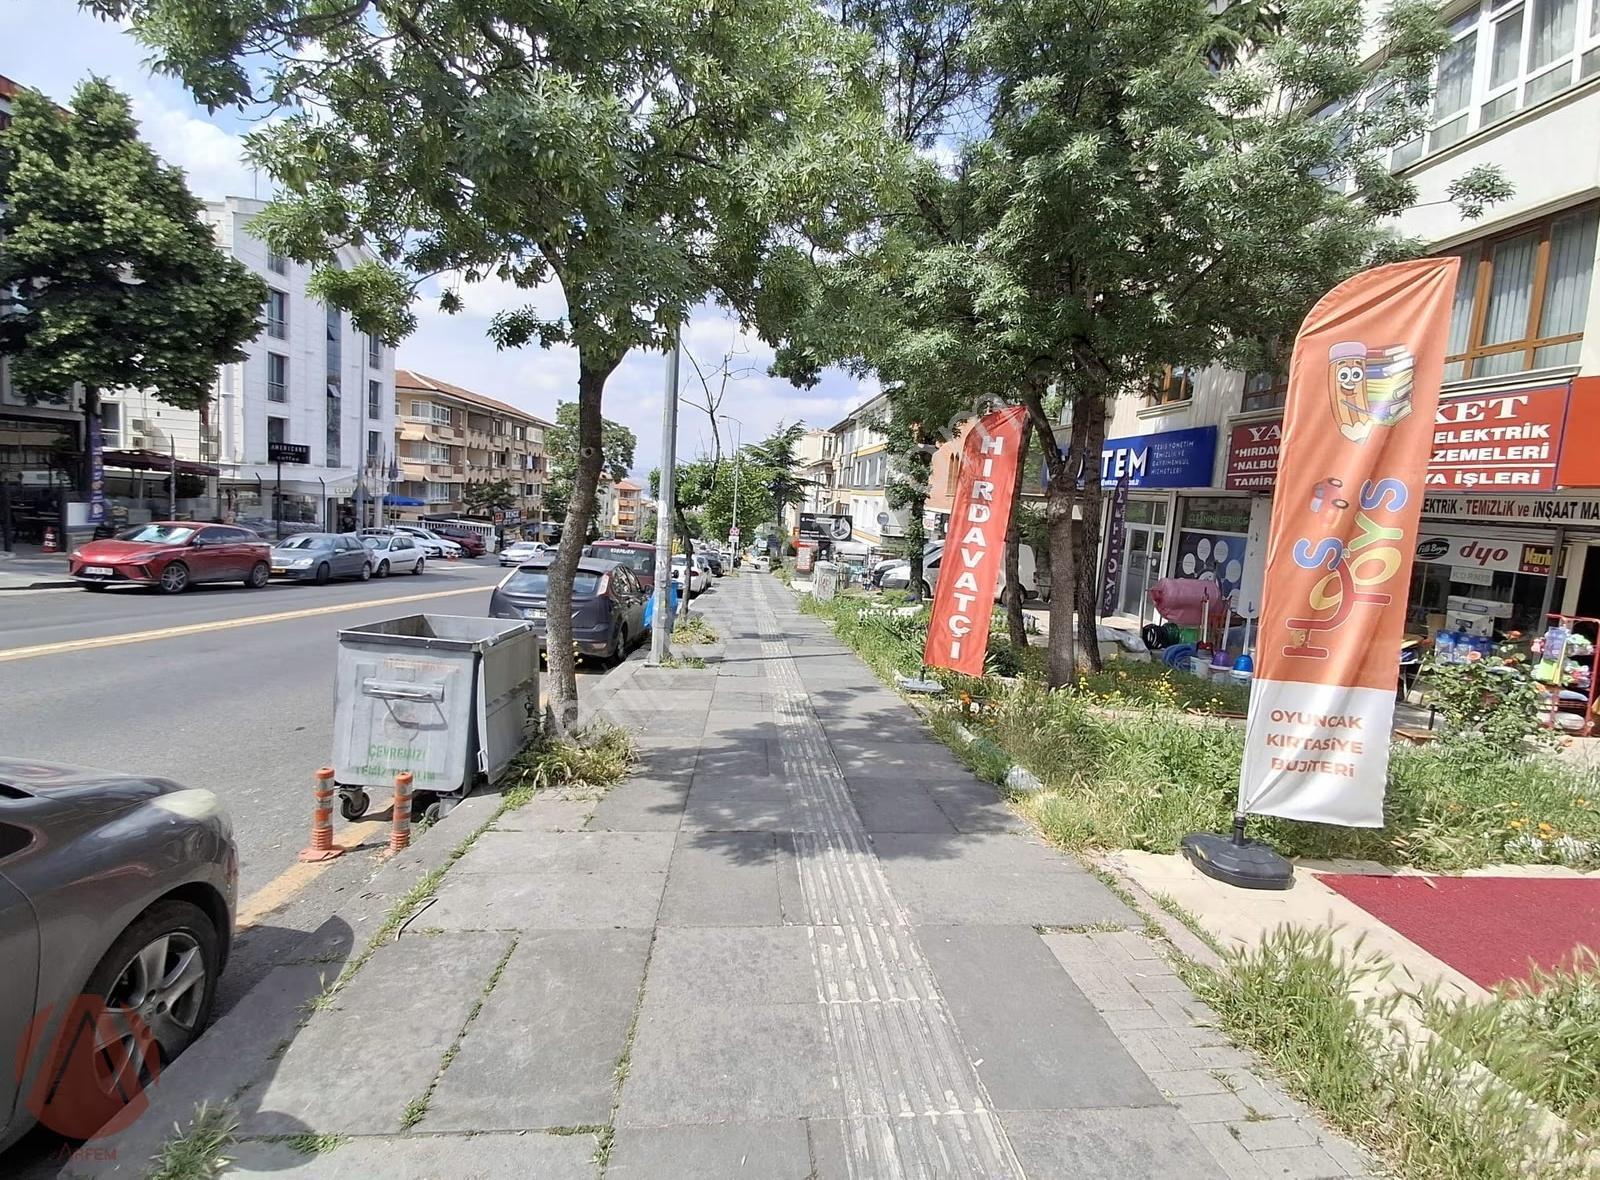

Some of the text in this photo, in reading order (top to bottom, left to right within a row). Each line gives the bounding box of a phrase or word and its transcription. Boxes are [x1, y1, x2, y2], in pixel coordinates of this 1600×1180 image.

[1434, 423, 1551, 444] ELEKTRİK
[1101, 445, 1149, 479] TEM
[1428, 442, 1550, 462] ZEMELERİ
[1237, 459, 1279, 470] NALBU
[1455, 470, 1541, 488] İŞLERİ
[1518, 504, 1530, 517] ve
[948, 435, 1004, 660] HIRDAVATÇI
[1459, 541, 1509, 566] dyo
[1270, 709, 1364, 730] OYUNCAK
